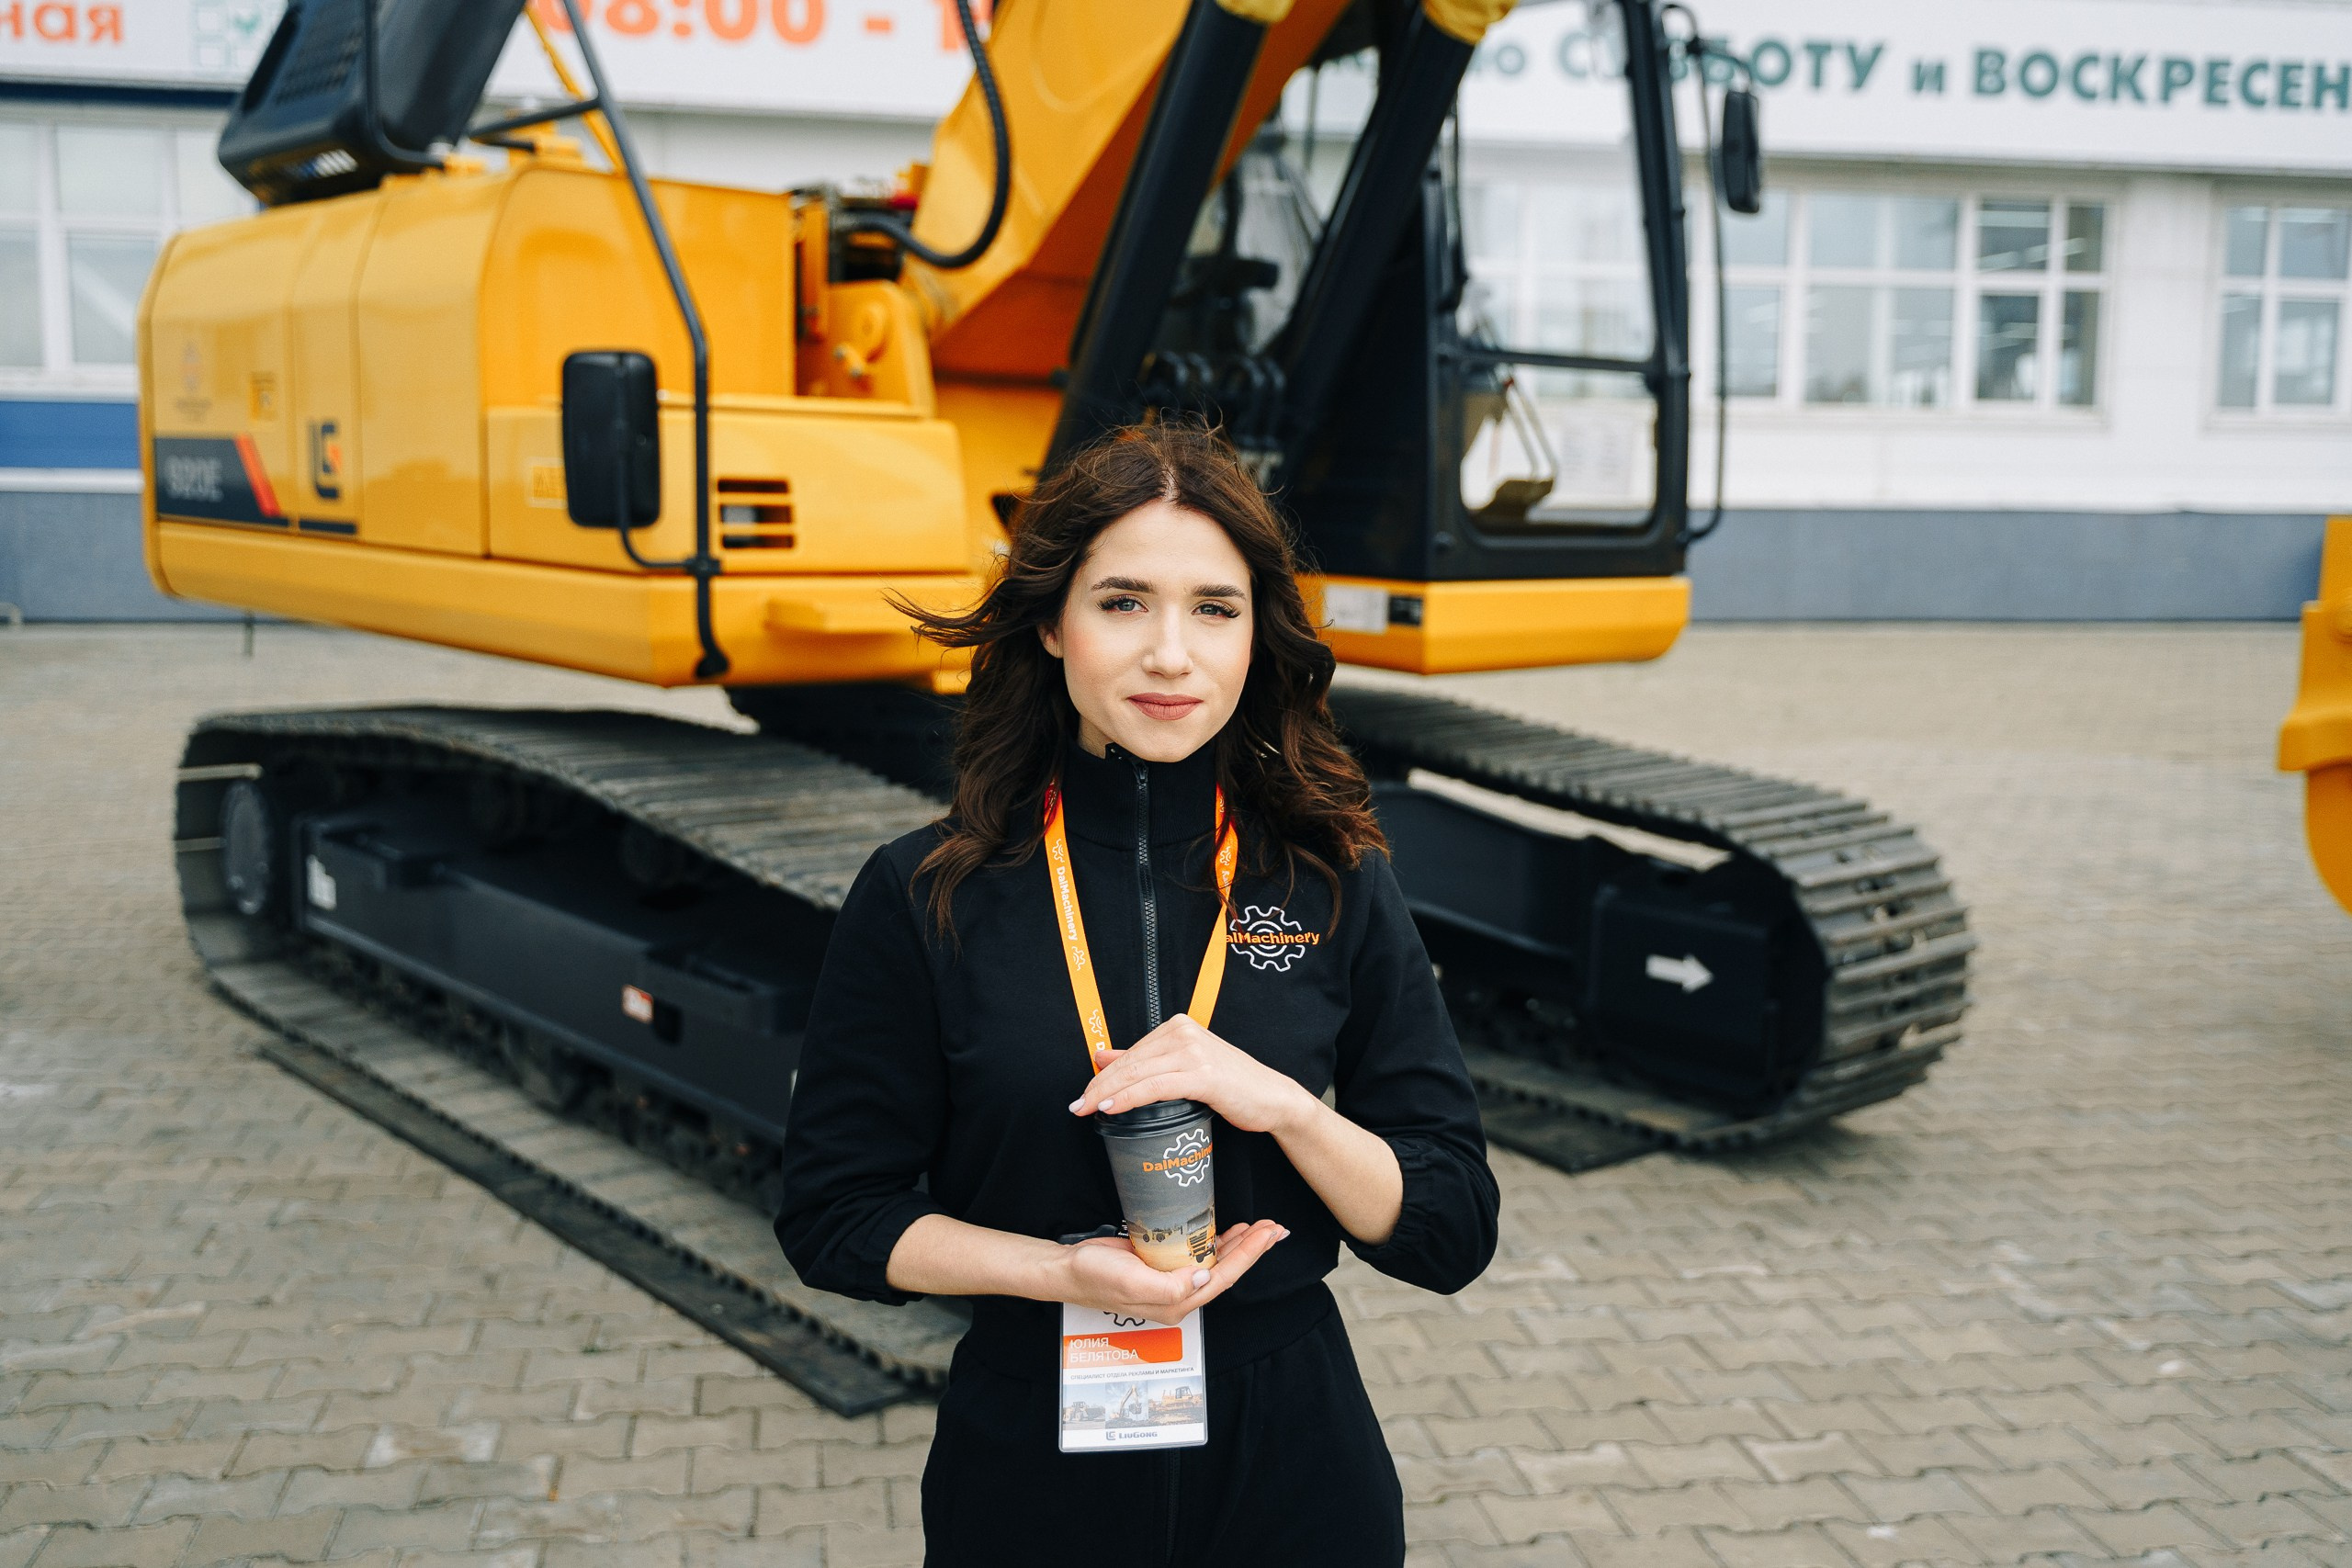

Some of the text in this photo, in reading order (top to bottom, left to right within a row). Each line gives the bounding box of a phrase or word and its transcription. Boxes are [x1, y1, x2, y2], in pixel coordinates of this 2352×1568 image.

[1974, 49, 2352, 109] ВОСКРЕСЕН
[1057, 865, 1079, 941] DalMachinery
[1226, 931, 1320, 945] alMachinery
[1069, 1337, 1109, 1349] ЮЛИЯ
[1070, 1348, 1139, 1363] БЕЛЯТОВА
